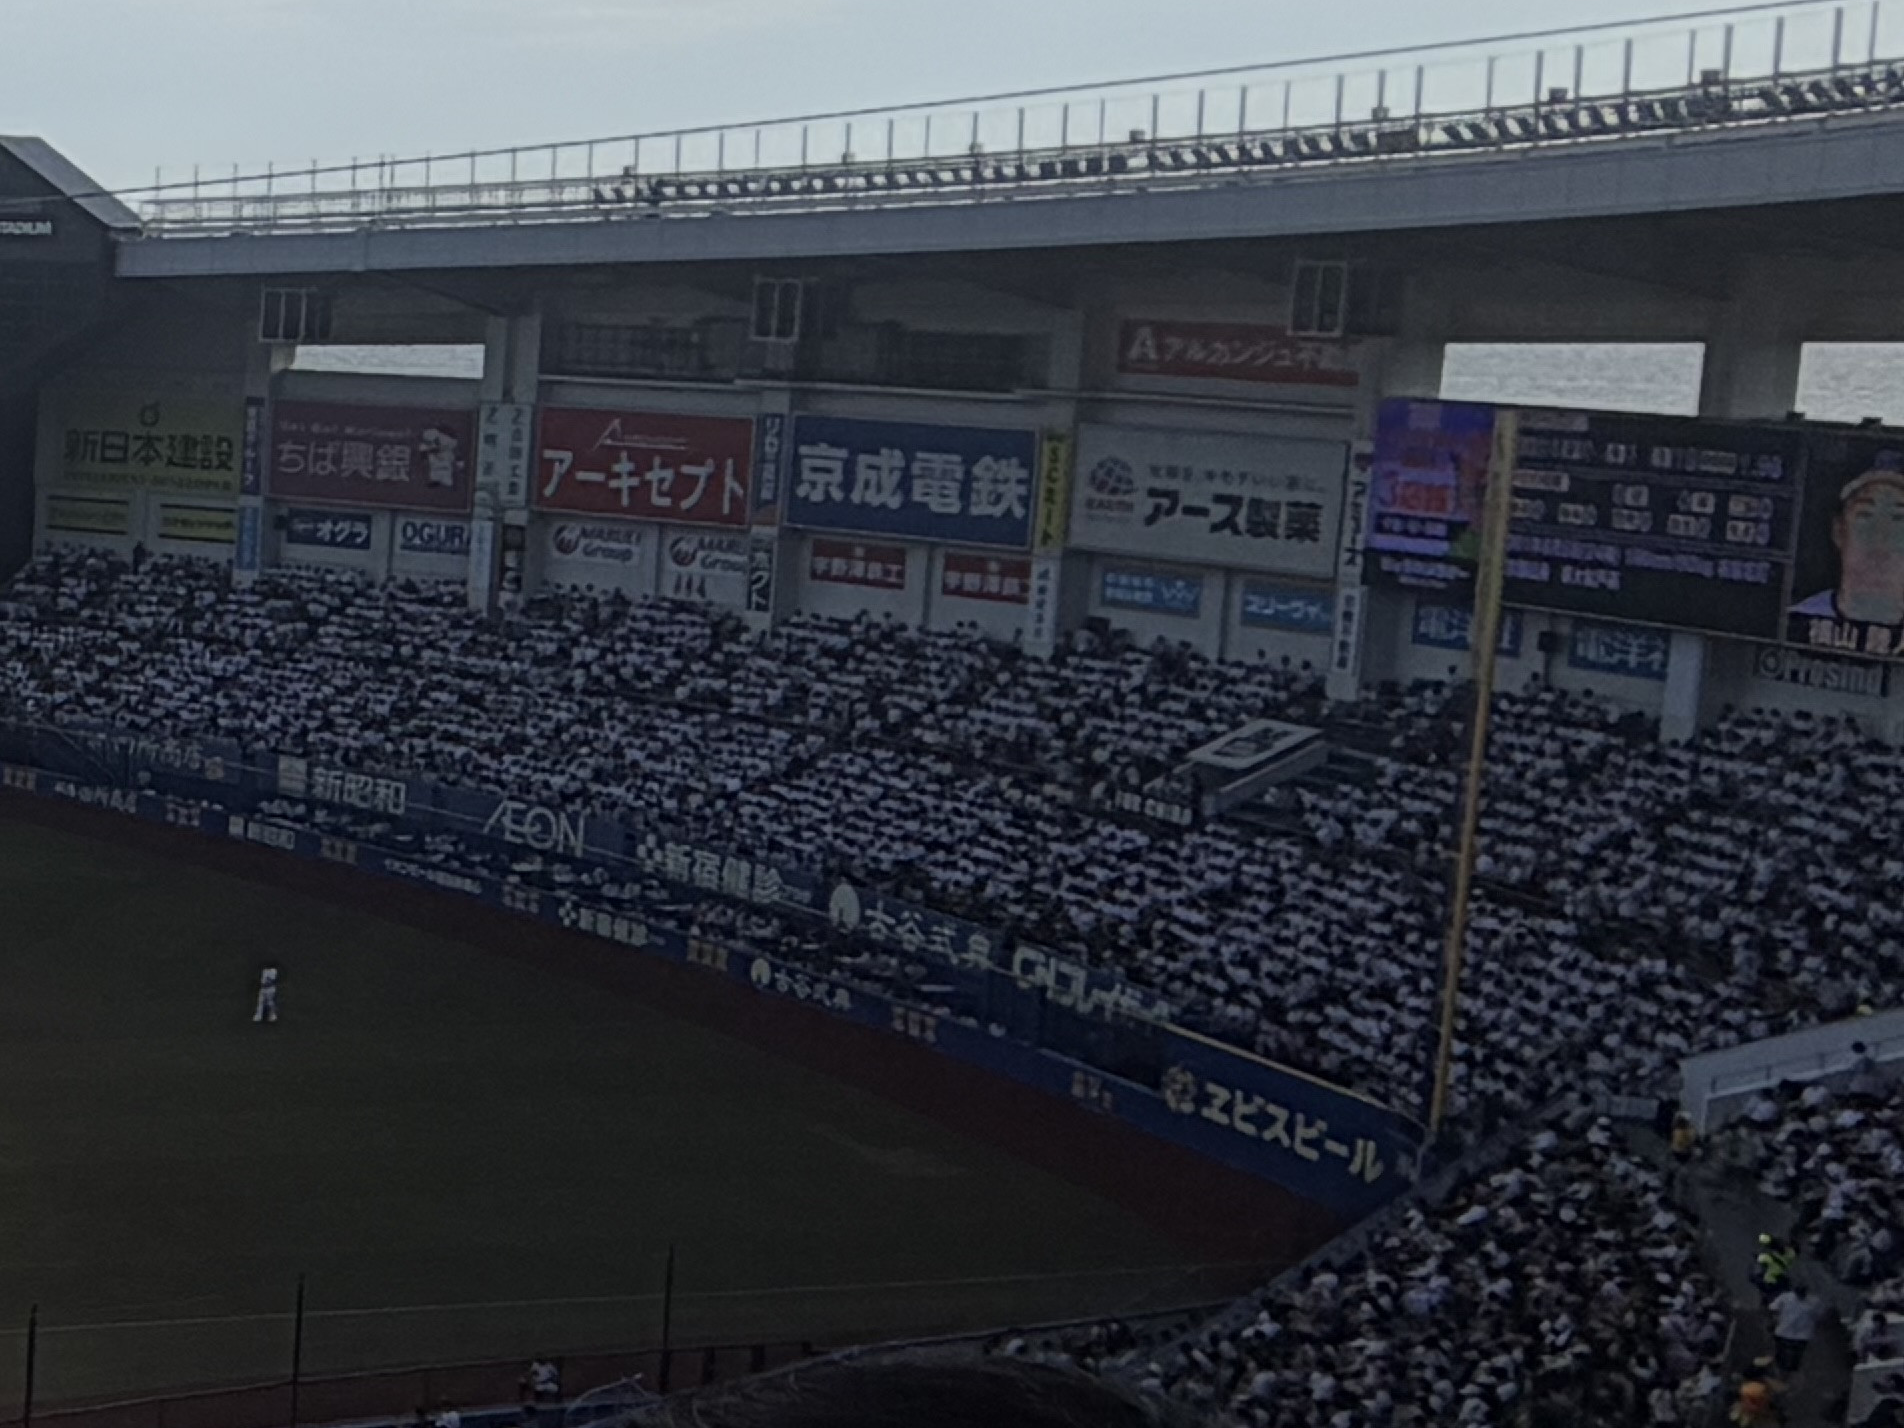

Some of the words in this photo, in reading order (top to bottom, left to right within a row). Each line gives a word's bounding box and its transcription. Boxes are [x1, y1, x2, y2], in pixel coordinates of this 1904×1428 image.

[64, 428, 233, 471] 新日本建設
[277, 440, 411, 482] ちば興銀
[541, 449, 744, 514] アーキセプト
[799, 444, 1028, 520] 京成電鉄
[1143, 486, 1323, 542] アース製薬
[700, 555, 748, 573] Grou
[311, 766, 406, 815] 新昭和
[1201, 1081, 1385, 1186] ヱビスビール
